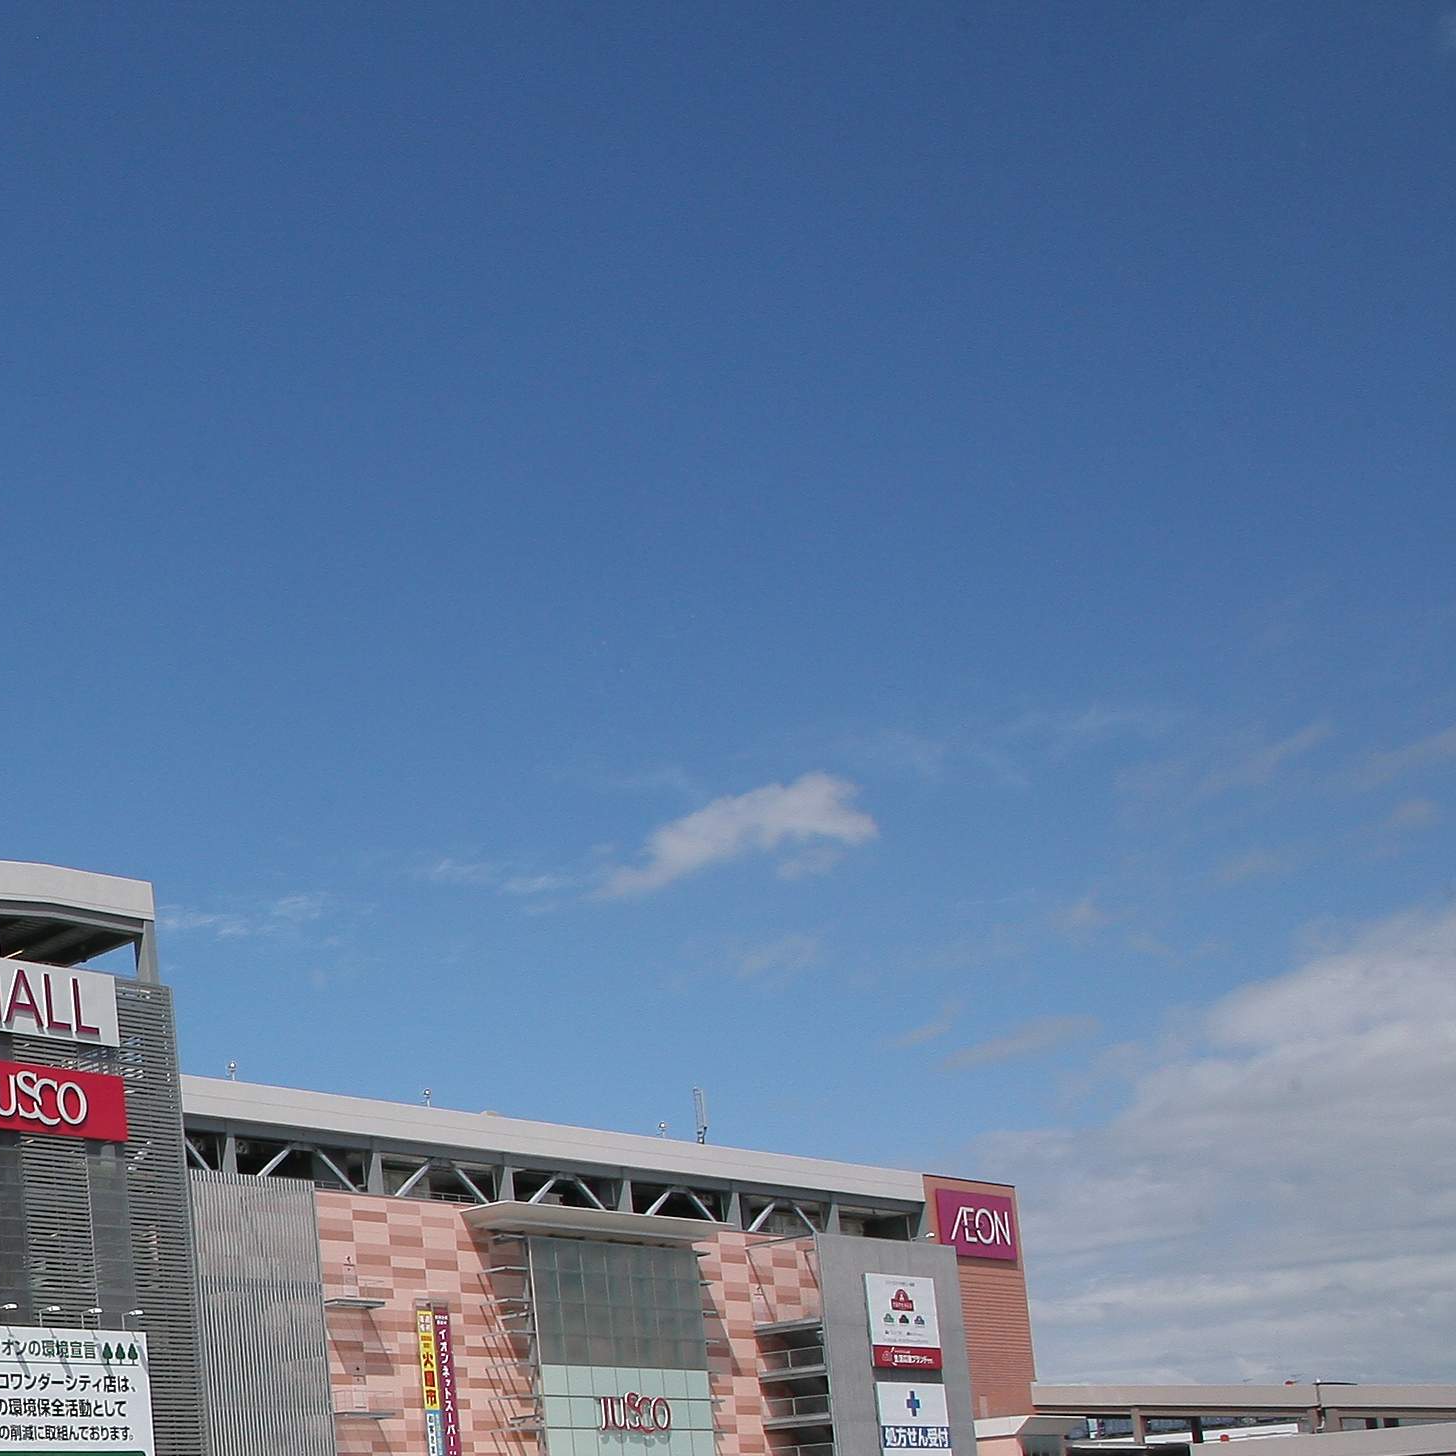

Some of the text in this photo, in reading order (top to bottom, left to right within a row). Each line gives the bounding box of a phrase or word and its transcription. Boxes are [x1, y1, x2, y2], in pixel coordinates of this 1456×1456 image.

[600, 1391, 671, 1435] JUSCO
[885, 1427, 949, 1447] 処方せん受付
